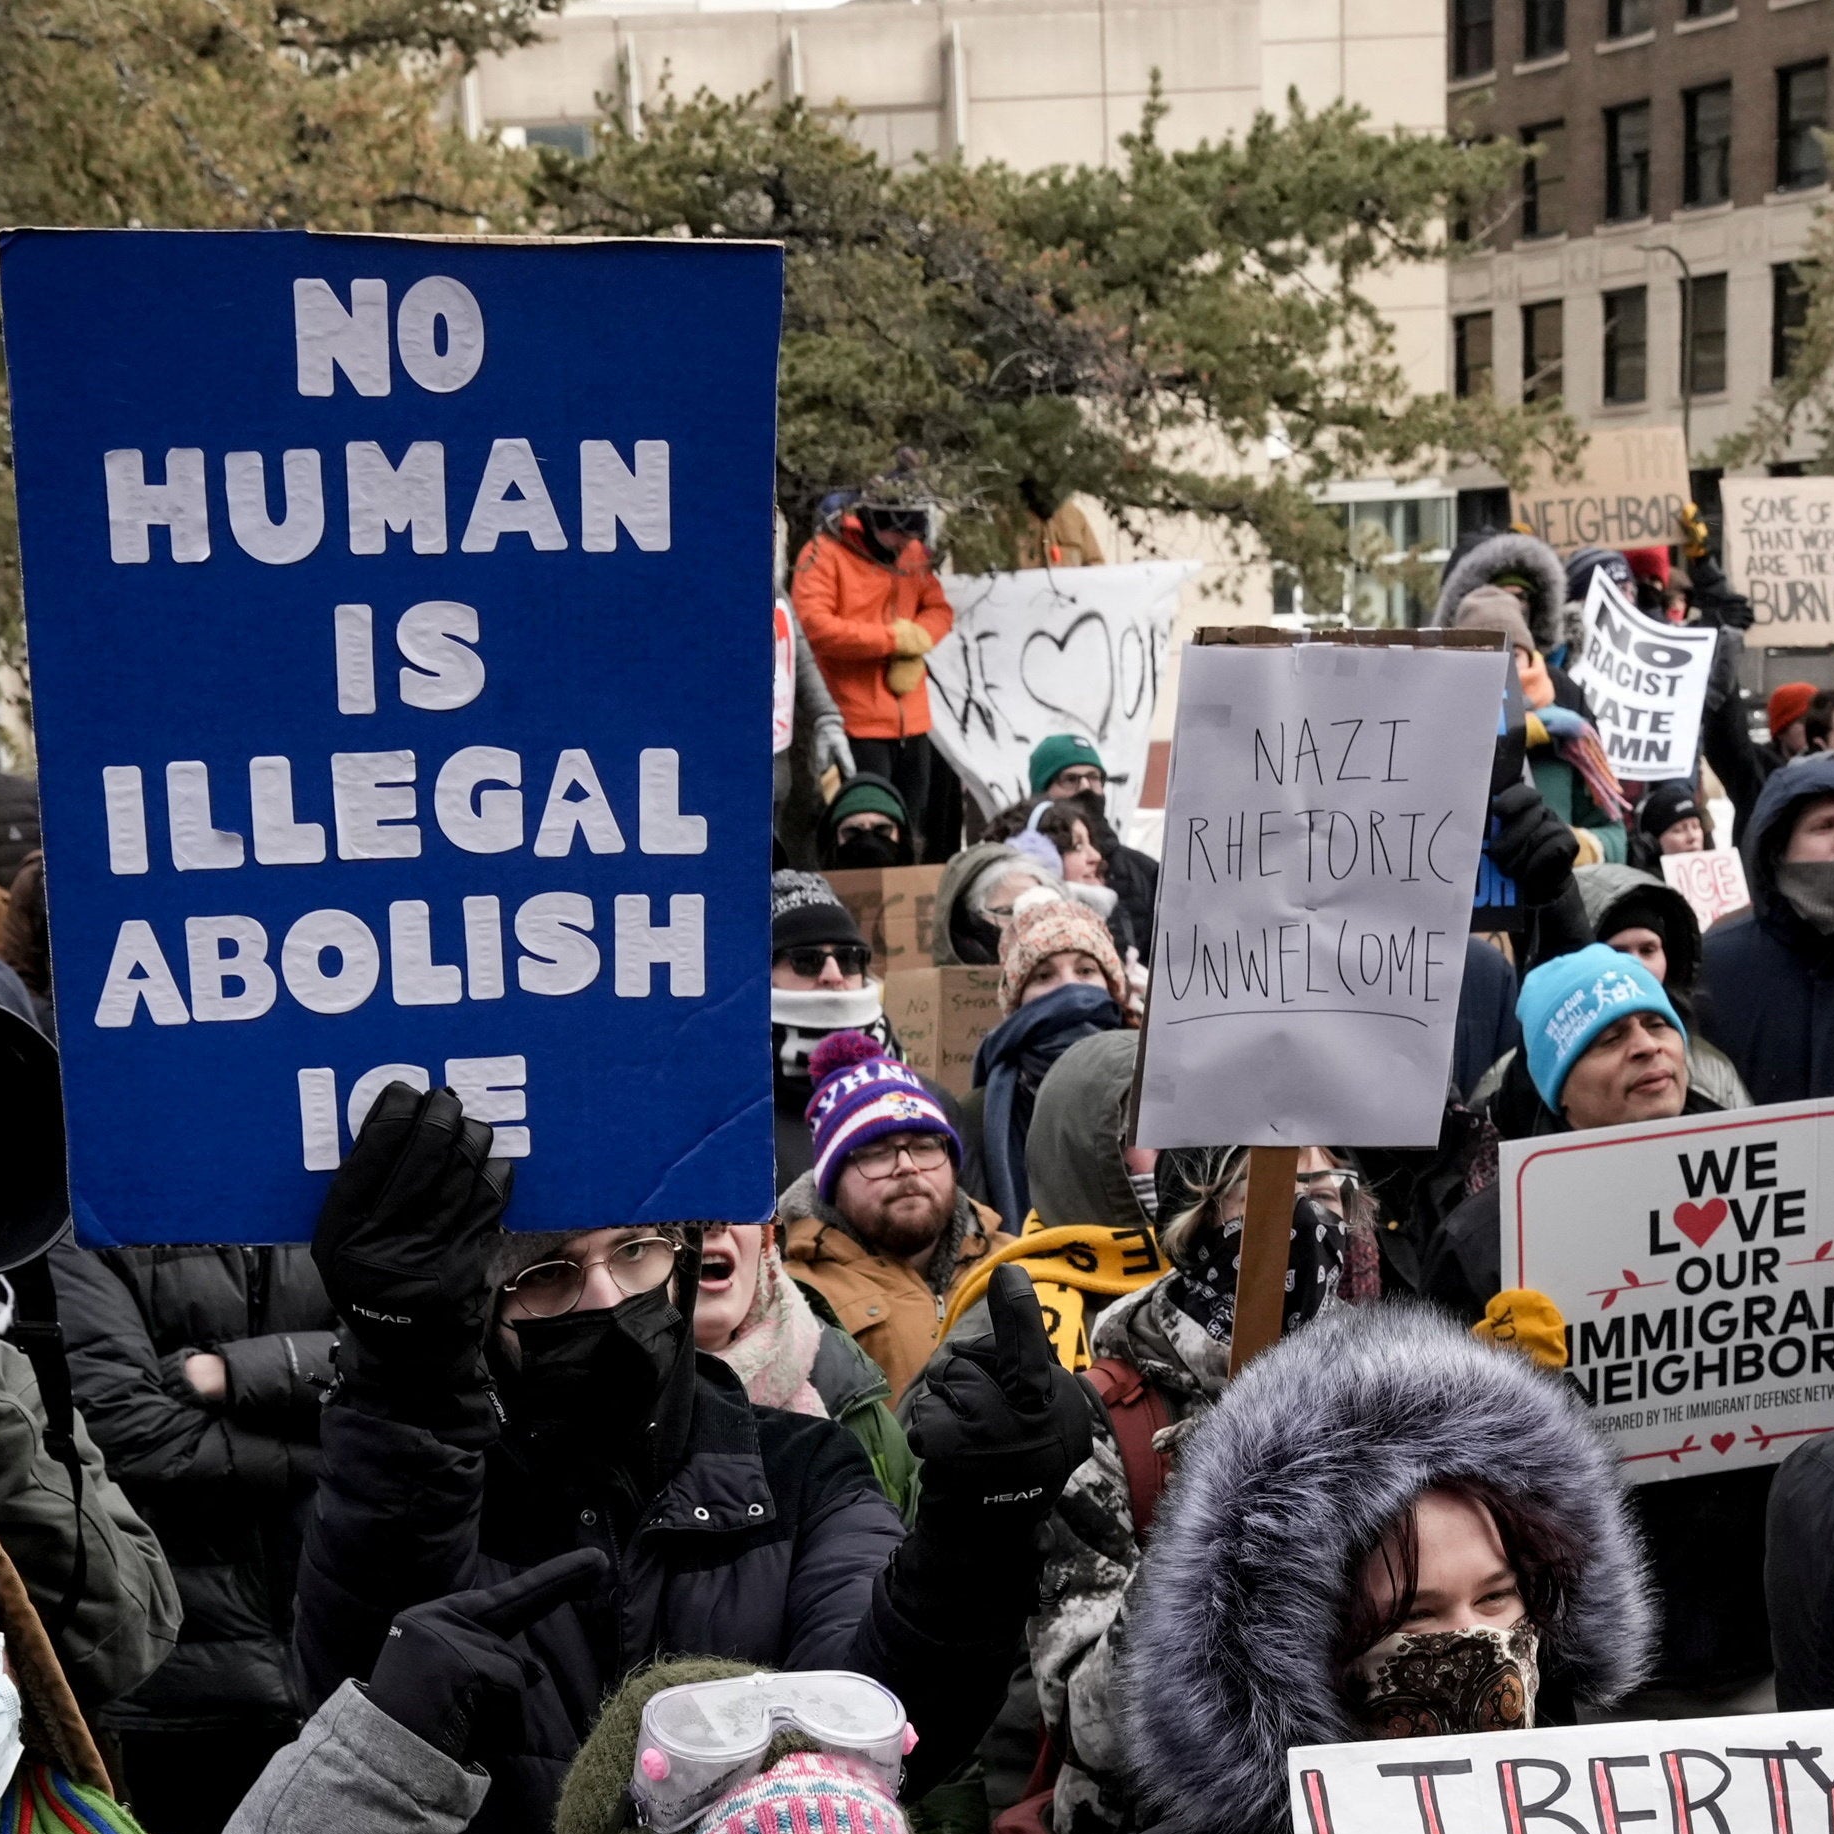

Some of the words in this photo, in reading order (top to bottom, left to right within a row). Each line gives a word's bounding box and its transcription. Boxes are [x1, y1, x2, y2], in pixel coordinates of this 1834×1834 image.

[293, 275, 484, 397] NO
[104, 438, 671, 564] HUMAN
[1741, 496, 1802, 525] SOME
[1807, 501, 1832, 523] OF
[1741, 528, 1793, 553] THAT
[1745, 553, 1788, 575] ARE
[1798, 554, 1831, 575] THE
[1748, 584, 1832, 626] BURN
[334, 600, 485, 714] IS
[1594, 600, 1692, 668] NO
[1587, 645, 1683, 698] RACIST
[1254, 718, 1410, 785] NAZI
[1607, 736, 1673, 762] MN
[102, 746, 707, 875] ILLEGAL
[1188, 809, 1454, 884] RHETORIC
[1677, 857, 1743, 902] ICE
[94, 891, 705, 1027] ABOLISH
[1167, 920, 1446, 1003] UNWELCOME
[1678, 1141, 1778, 1198] WE
[1675, 1247, 1780, 1295] OUR
[352, 1303, 412, 1324] HEAD
[1646, 1409, 1660, 1426] BY
[1664, 1406, 1683, 1421] THE
[1686, 1395, 1750, 1419] IMMIGRANT
[1754, 1387, 1802, 1409] DEFENSE
